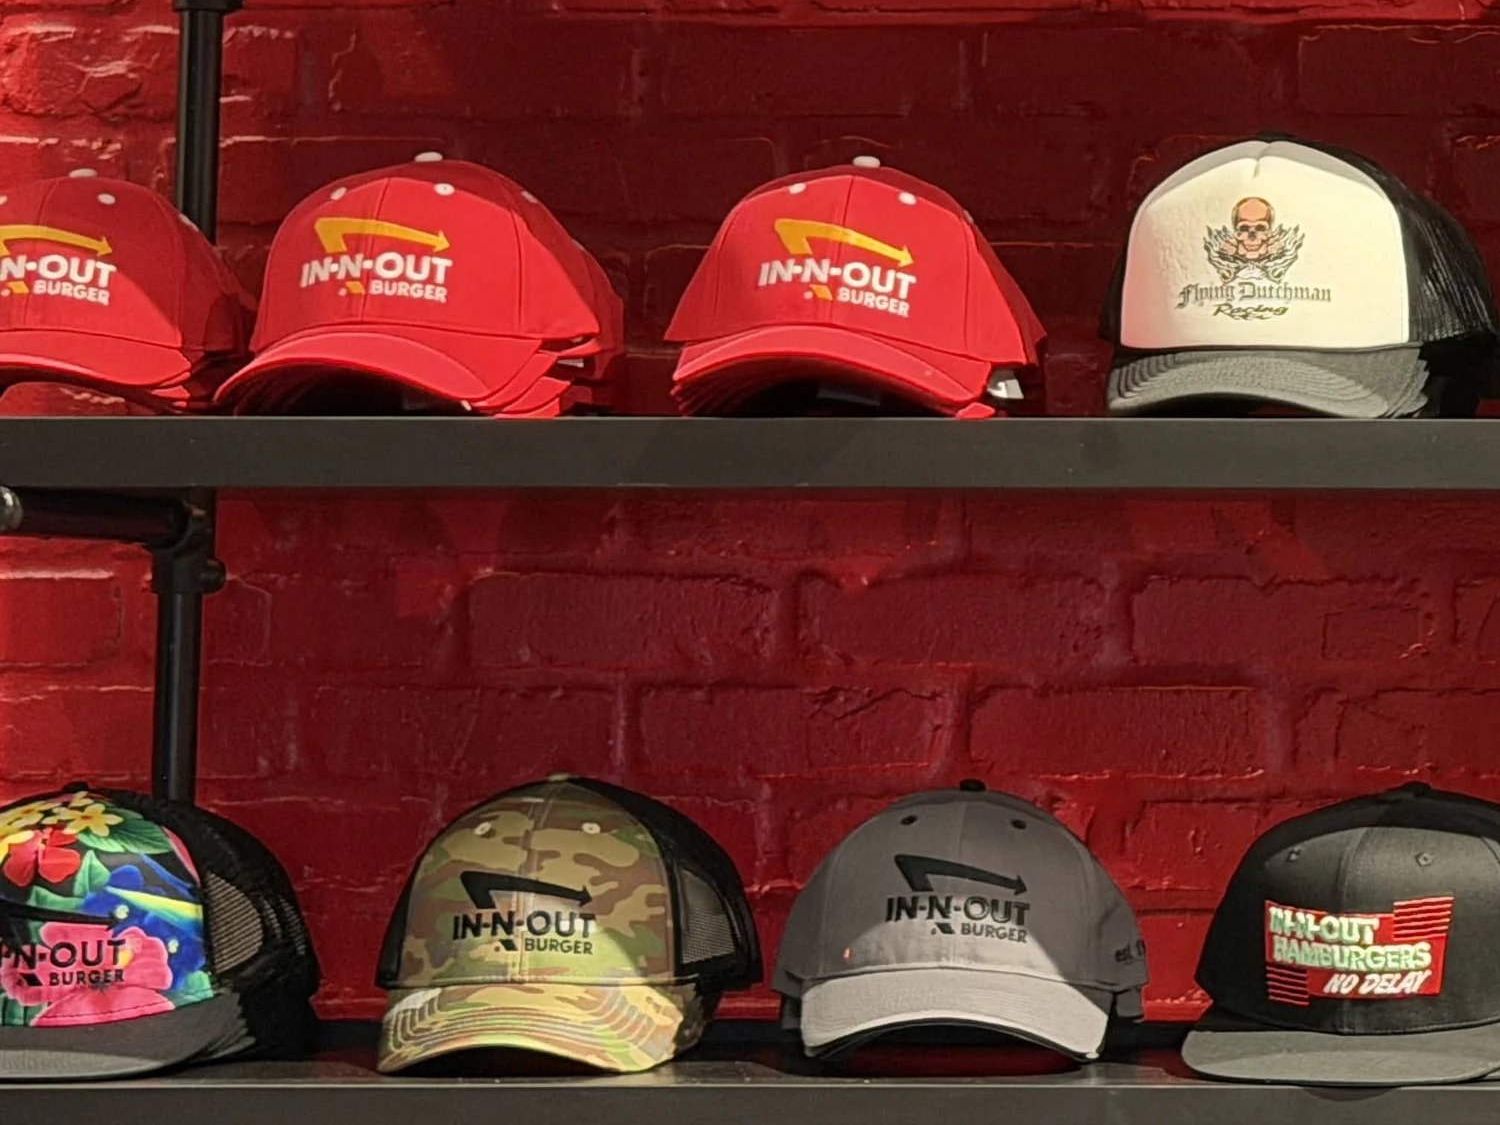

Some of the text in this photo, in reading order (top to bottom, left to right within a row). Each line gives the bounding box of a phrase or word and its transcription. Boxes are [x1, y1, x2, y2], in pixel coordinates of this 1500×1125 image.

[300, 251, 453, 289] IN-N-OUT
[757, 257, 917, 300] IN-N-OUT
[32, 279, 110, 306] BURGER
[369, 279, 448, 304] BURGER
[837, 286, 910, 317] BURGER
[1175, 280, 1332, 309] Flying Dutchman
[1212, 302, 1290, 318] Racing
[453, 909, 596, 940] IN-N-OUT
[885, 894, 1030, 926] IN-N-OUT
[960, 922, 1028, 943] BURGER
[1268, 906, 1380, 944] IN-N-OUT
[524, 937, 593, 955] BURGER
[1272, 935, 1433, 972] HAMBURGERS
[49, 968, 125, 987] BURGER
[1323, 970, 1433, 995] NO DELAY
